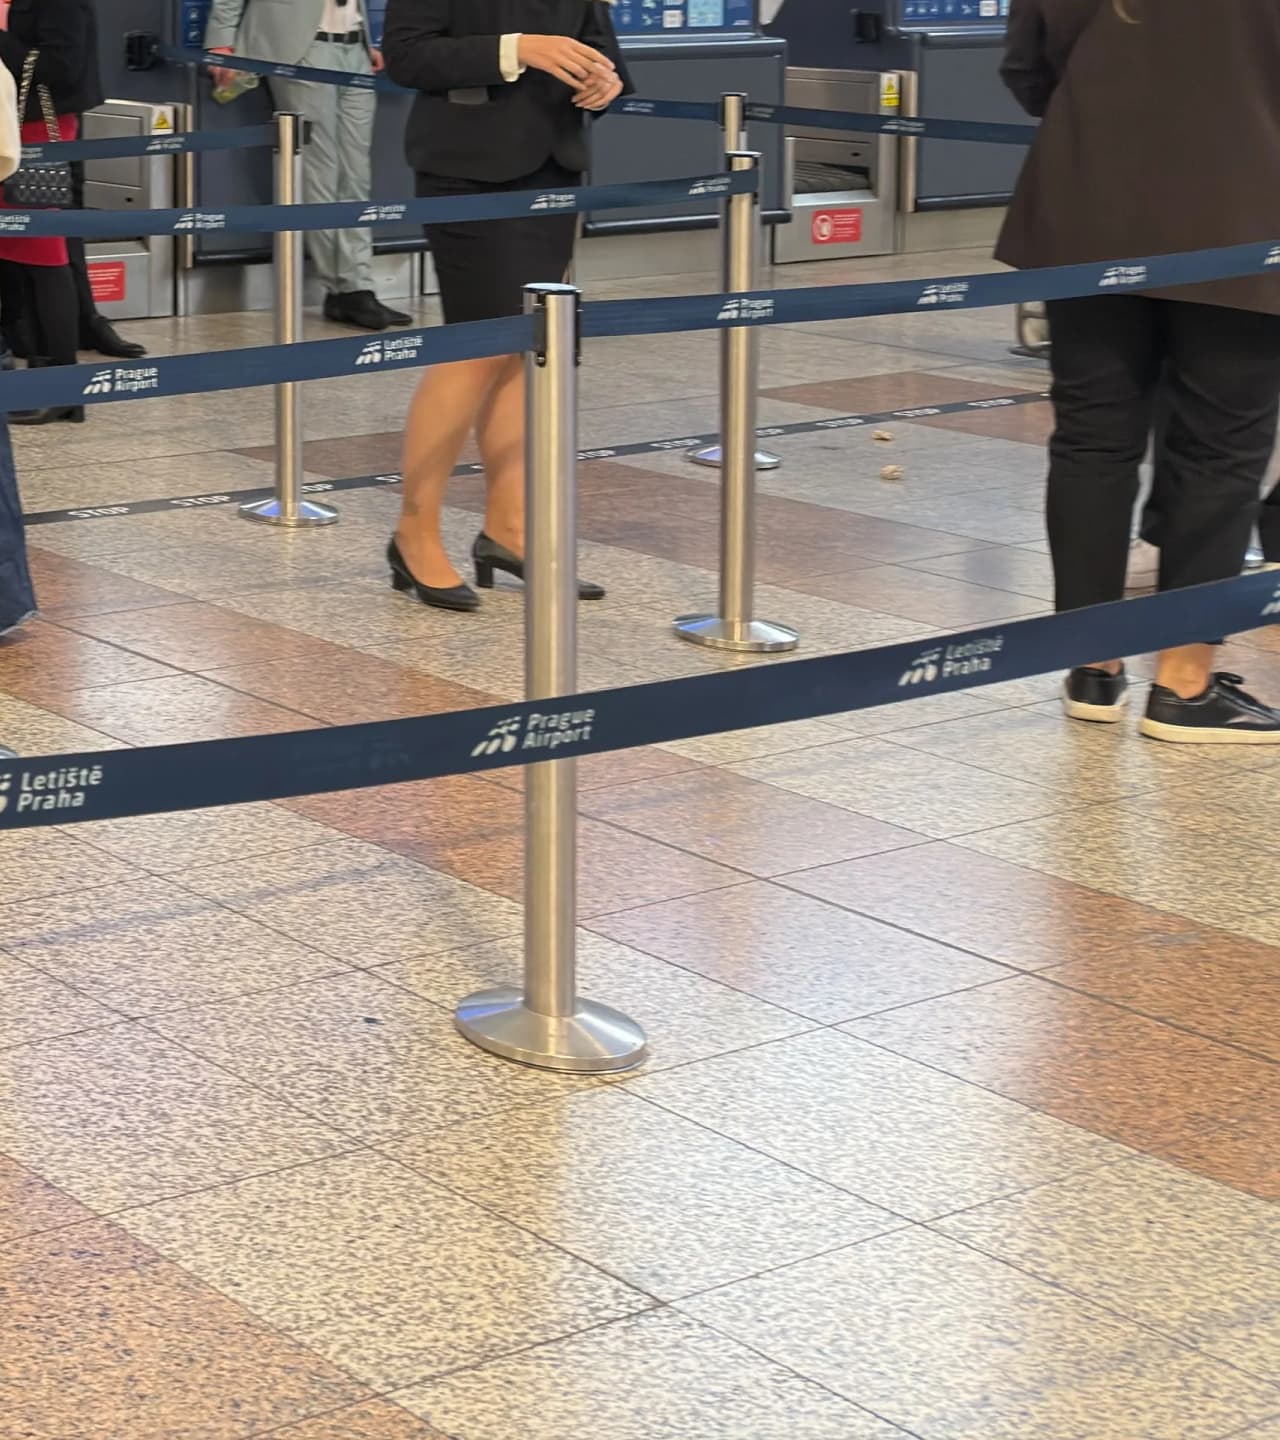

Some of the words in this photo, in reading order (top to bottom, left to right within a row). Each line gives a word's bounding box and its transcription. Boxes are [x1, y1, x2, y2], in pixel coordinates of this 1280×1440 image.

[383, 348, 417, 361] Praha
[114, 367, 159, 381] Prague
[114, 378, 159, 393] Airport
[170, 495, 230, 508] STOP
[67, 506, 129, 519] STOP
[942, 657, 992, 678] Praha
[526, 709, 595, 730] Prague
[521, 725, 592, 749] Airport
[21, 765, 103, 791] Letiště
[16, 790, 85, 813] Praha
